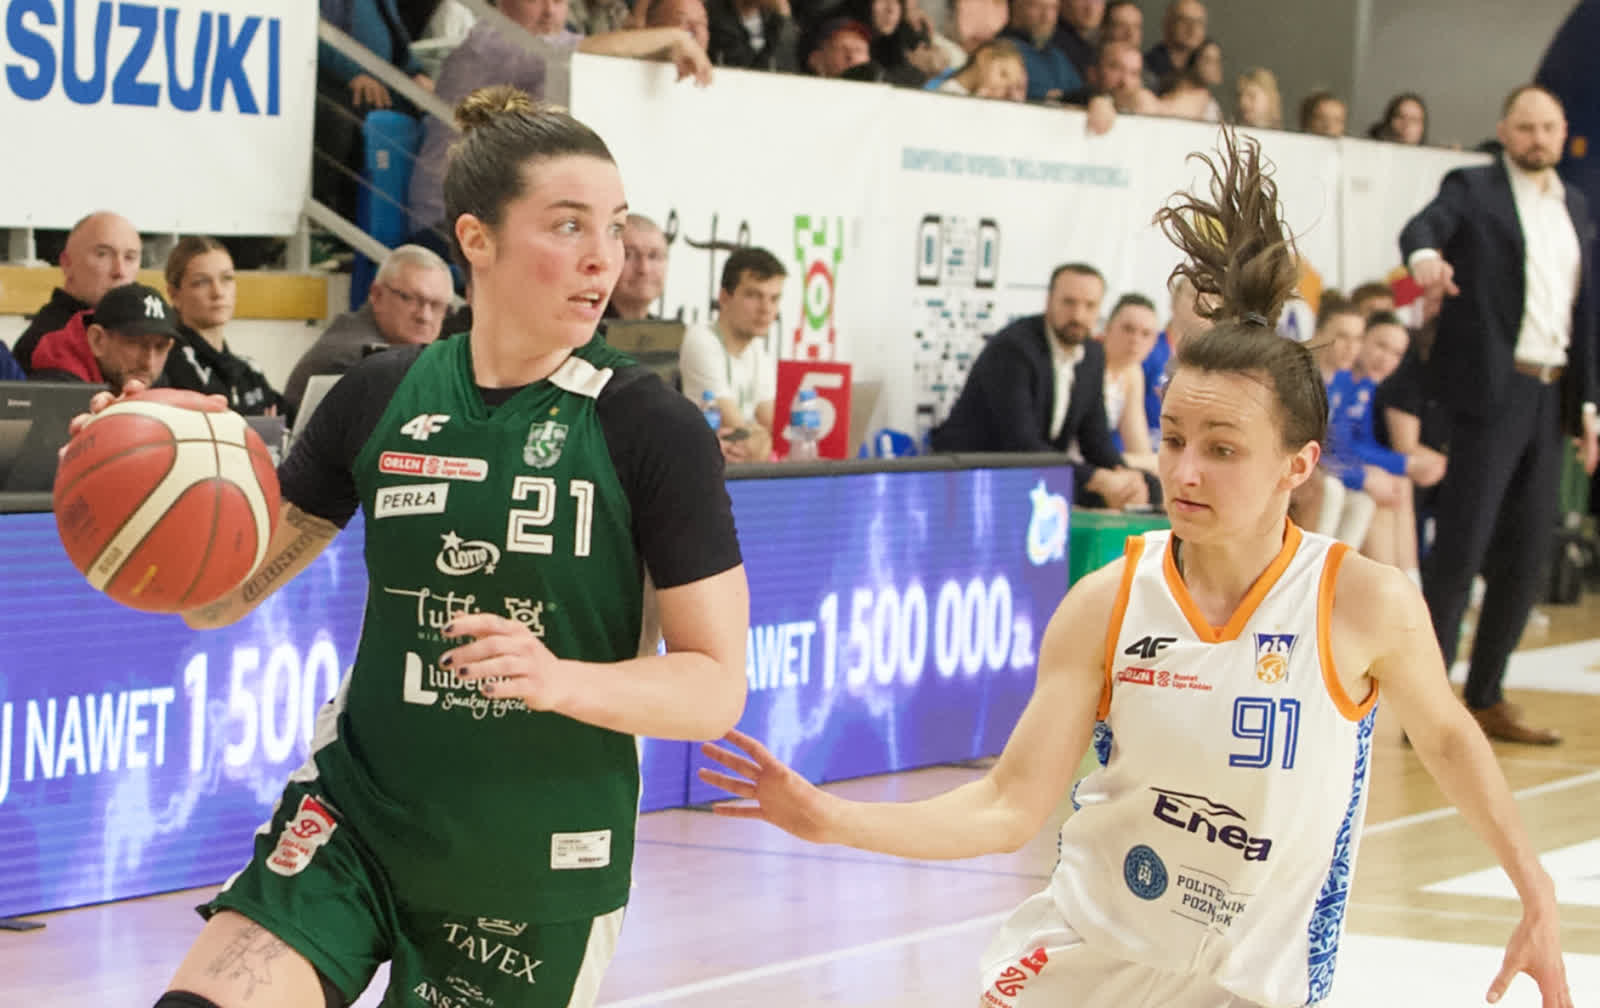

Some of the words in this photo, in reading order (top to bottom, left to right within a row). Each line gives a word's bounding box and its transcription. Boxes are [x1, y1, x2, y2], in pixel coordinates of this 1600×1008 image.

[4, 0, 281, 116] SUZUKI
[400, 413, 451, 440] 4F
[782, 372, 844, 443] 5
[383, 456, 422, 471] ORLEN
[382, 491, 436, 510] PERŁA
[506, 475, 595, 557] 21
[746, 621, 817, 690] AWET
[934, 574, 1013, 680] 000
[1125, 636, 1178, 659] 4F
[24, 687, 176, 782] NAWET
[1229, 697, 1301, 770] 91
[1153, 793, 1273, 862] Enea
[443, 922, 543, 984] TAVEX
